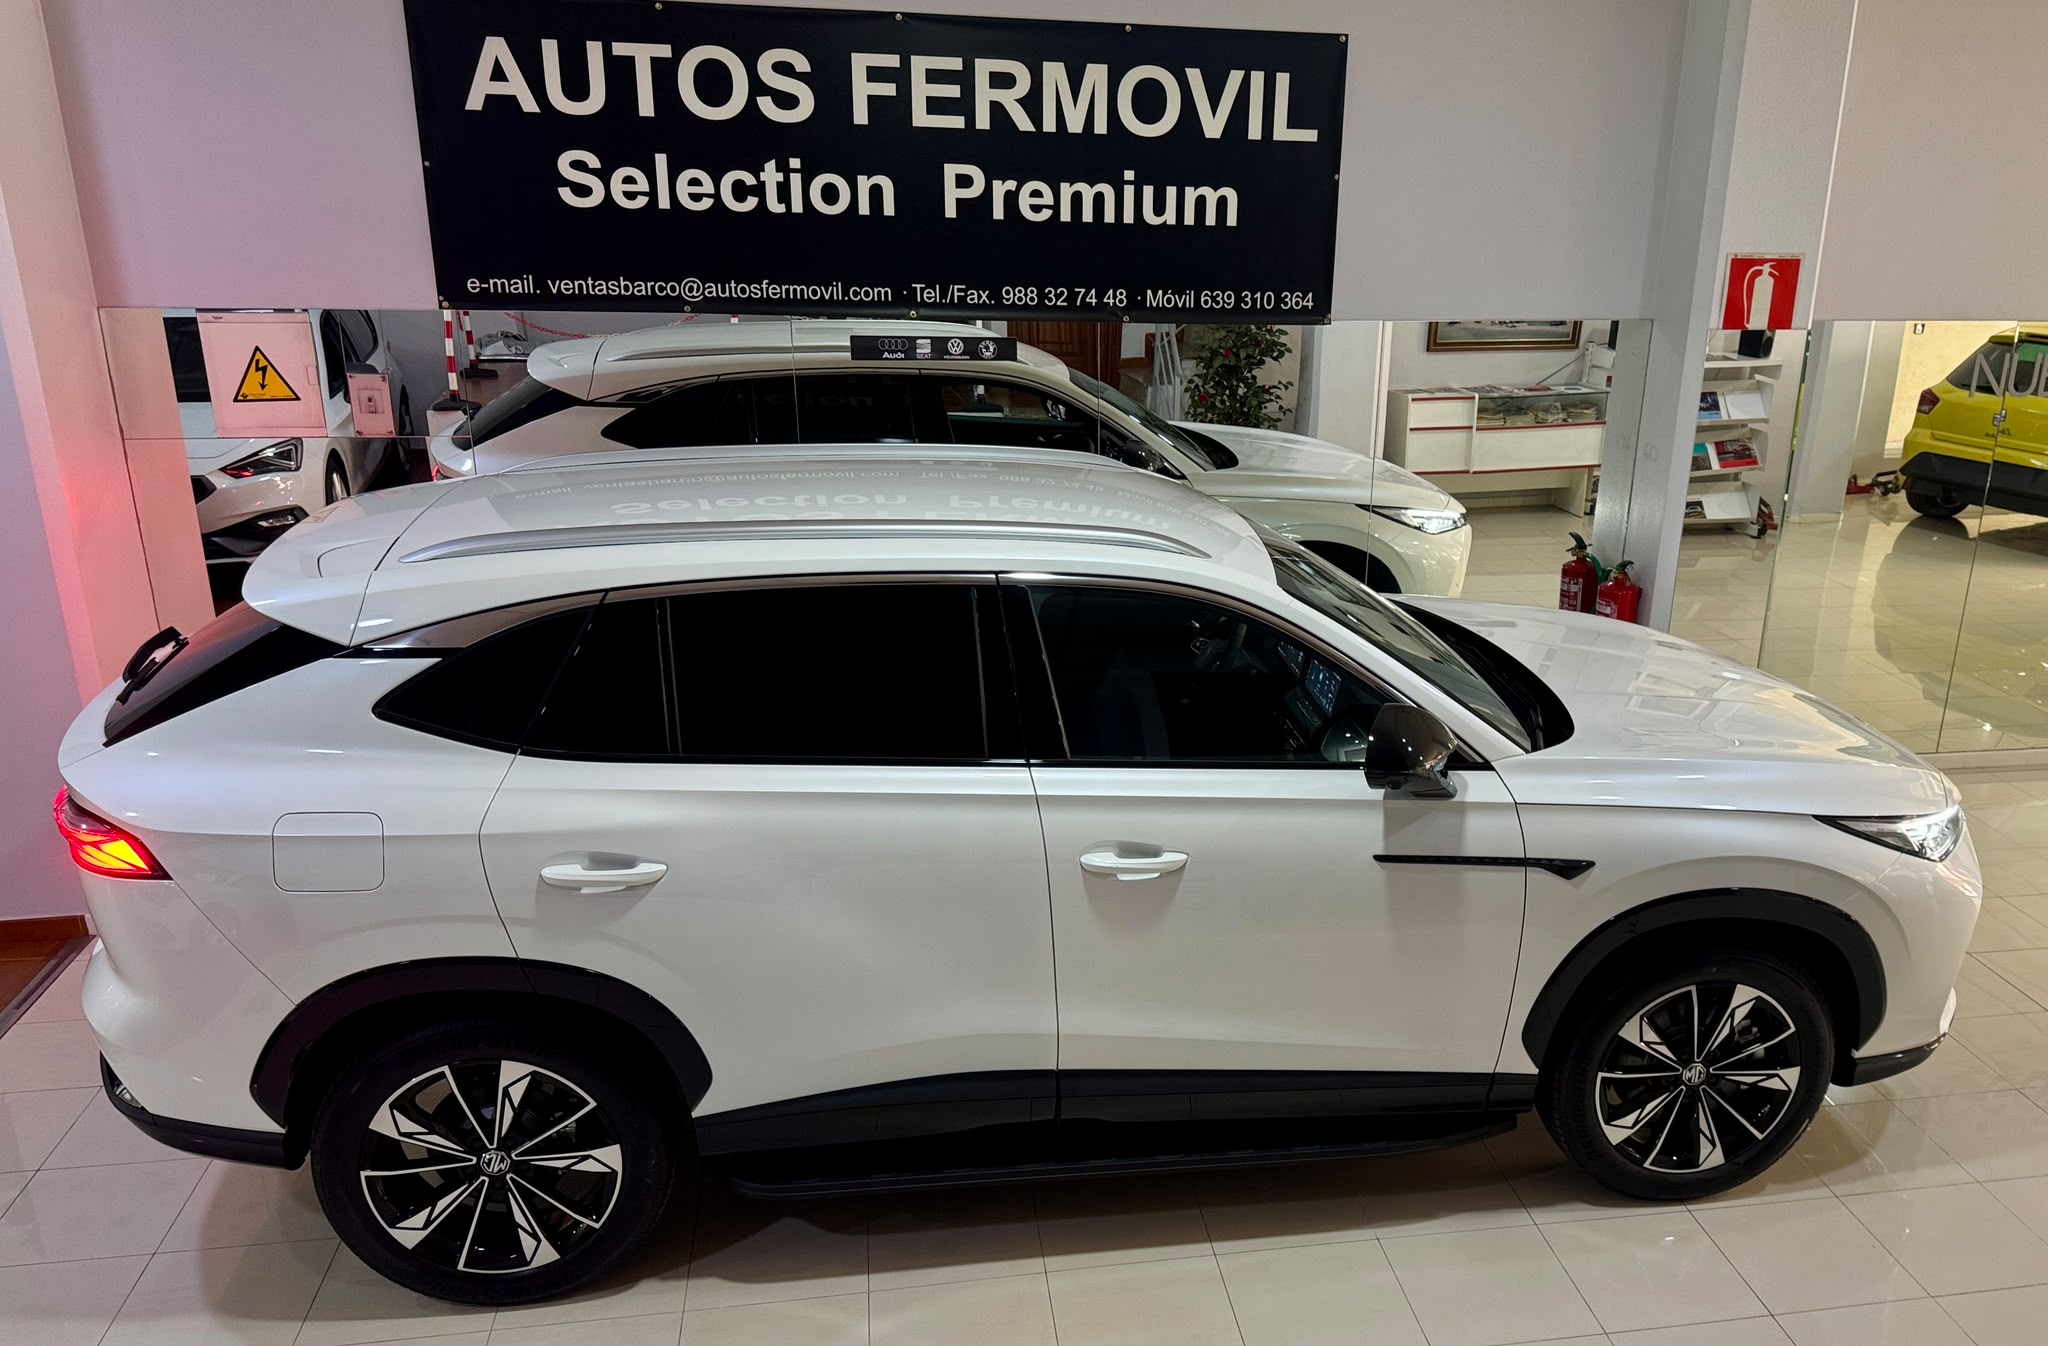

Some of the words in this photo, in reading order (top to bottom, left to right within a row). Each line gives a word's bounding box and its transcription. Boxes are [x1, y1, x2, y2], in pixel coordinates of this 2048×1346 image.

[464, 36, 815, 124] AUTOS
[850, 52, 1319, 143] FERMOVIL
[557, 149, 895, 217] Selection
[943, 163, 1238, 228] Premium
[466, 274, 541, 295] e-mail.
[547, 276, 892, 302] ventasbarco@autosfermovil.com
[1001, 286, 1038, 305] 988
[1044, 287, 1068, 306] 32
[1074, 288, 1098, 306] 74
[1103, 288, 1127, 307] 48
[1200, 290, 1235, 309] 639
[1240, 291, 1275, 310] 310
[1280, 291, 1314, 310] 364
[882, 351, 905, 359] Audi
